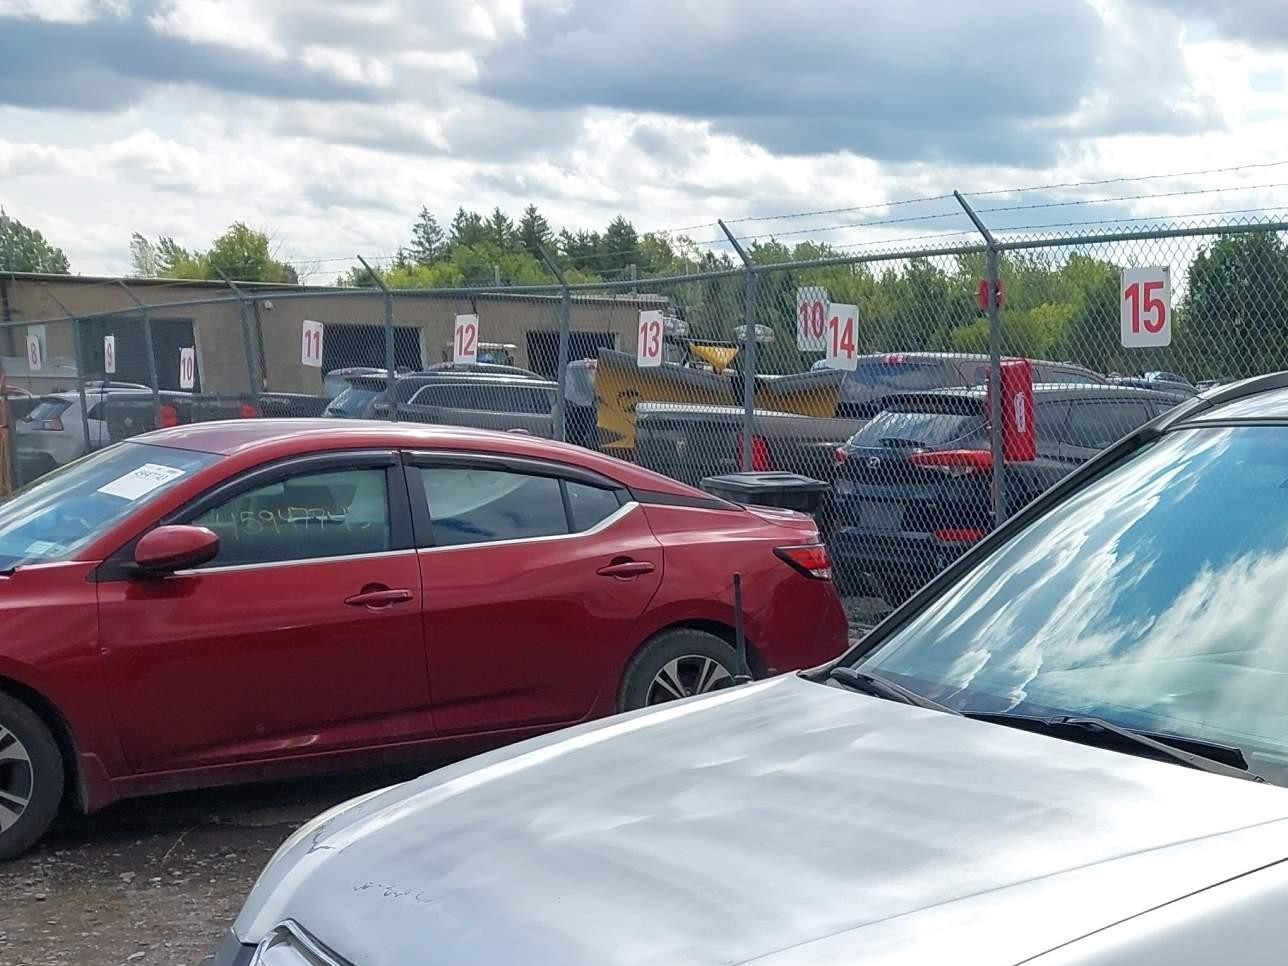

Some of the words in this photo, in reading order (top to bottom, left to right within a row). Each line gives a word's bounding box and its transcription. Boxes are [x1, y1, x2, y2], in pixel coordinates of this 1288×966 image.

[799, 301, 825, 338] 10
[1124, 280, 1166, 334] 15
[30, 343, 38, 365] 8
[304, 329, 320, 359] 11
[456, 324, 477, 357] 12
[640, 320, 661, 358] 13
[828, 316, 855, 359] 14
[106, 343, 113, 367] 9
[181, 357, 193, 381] 10
